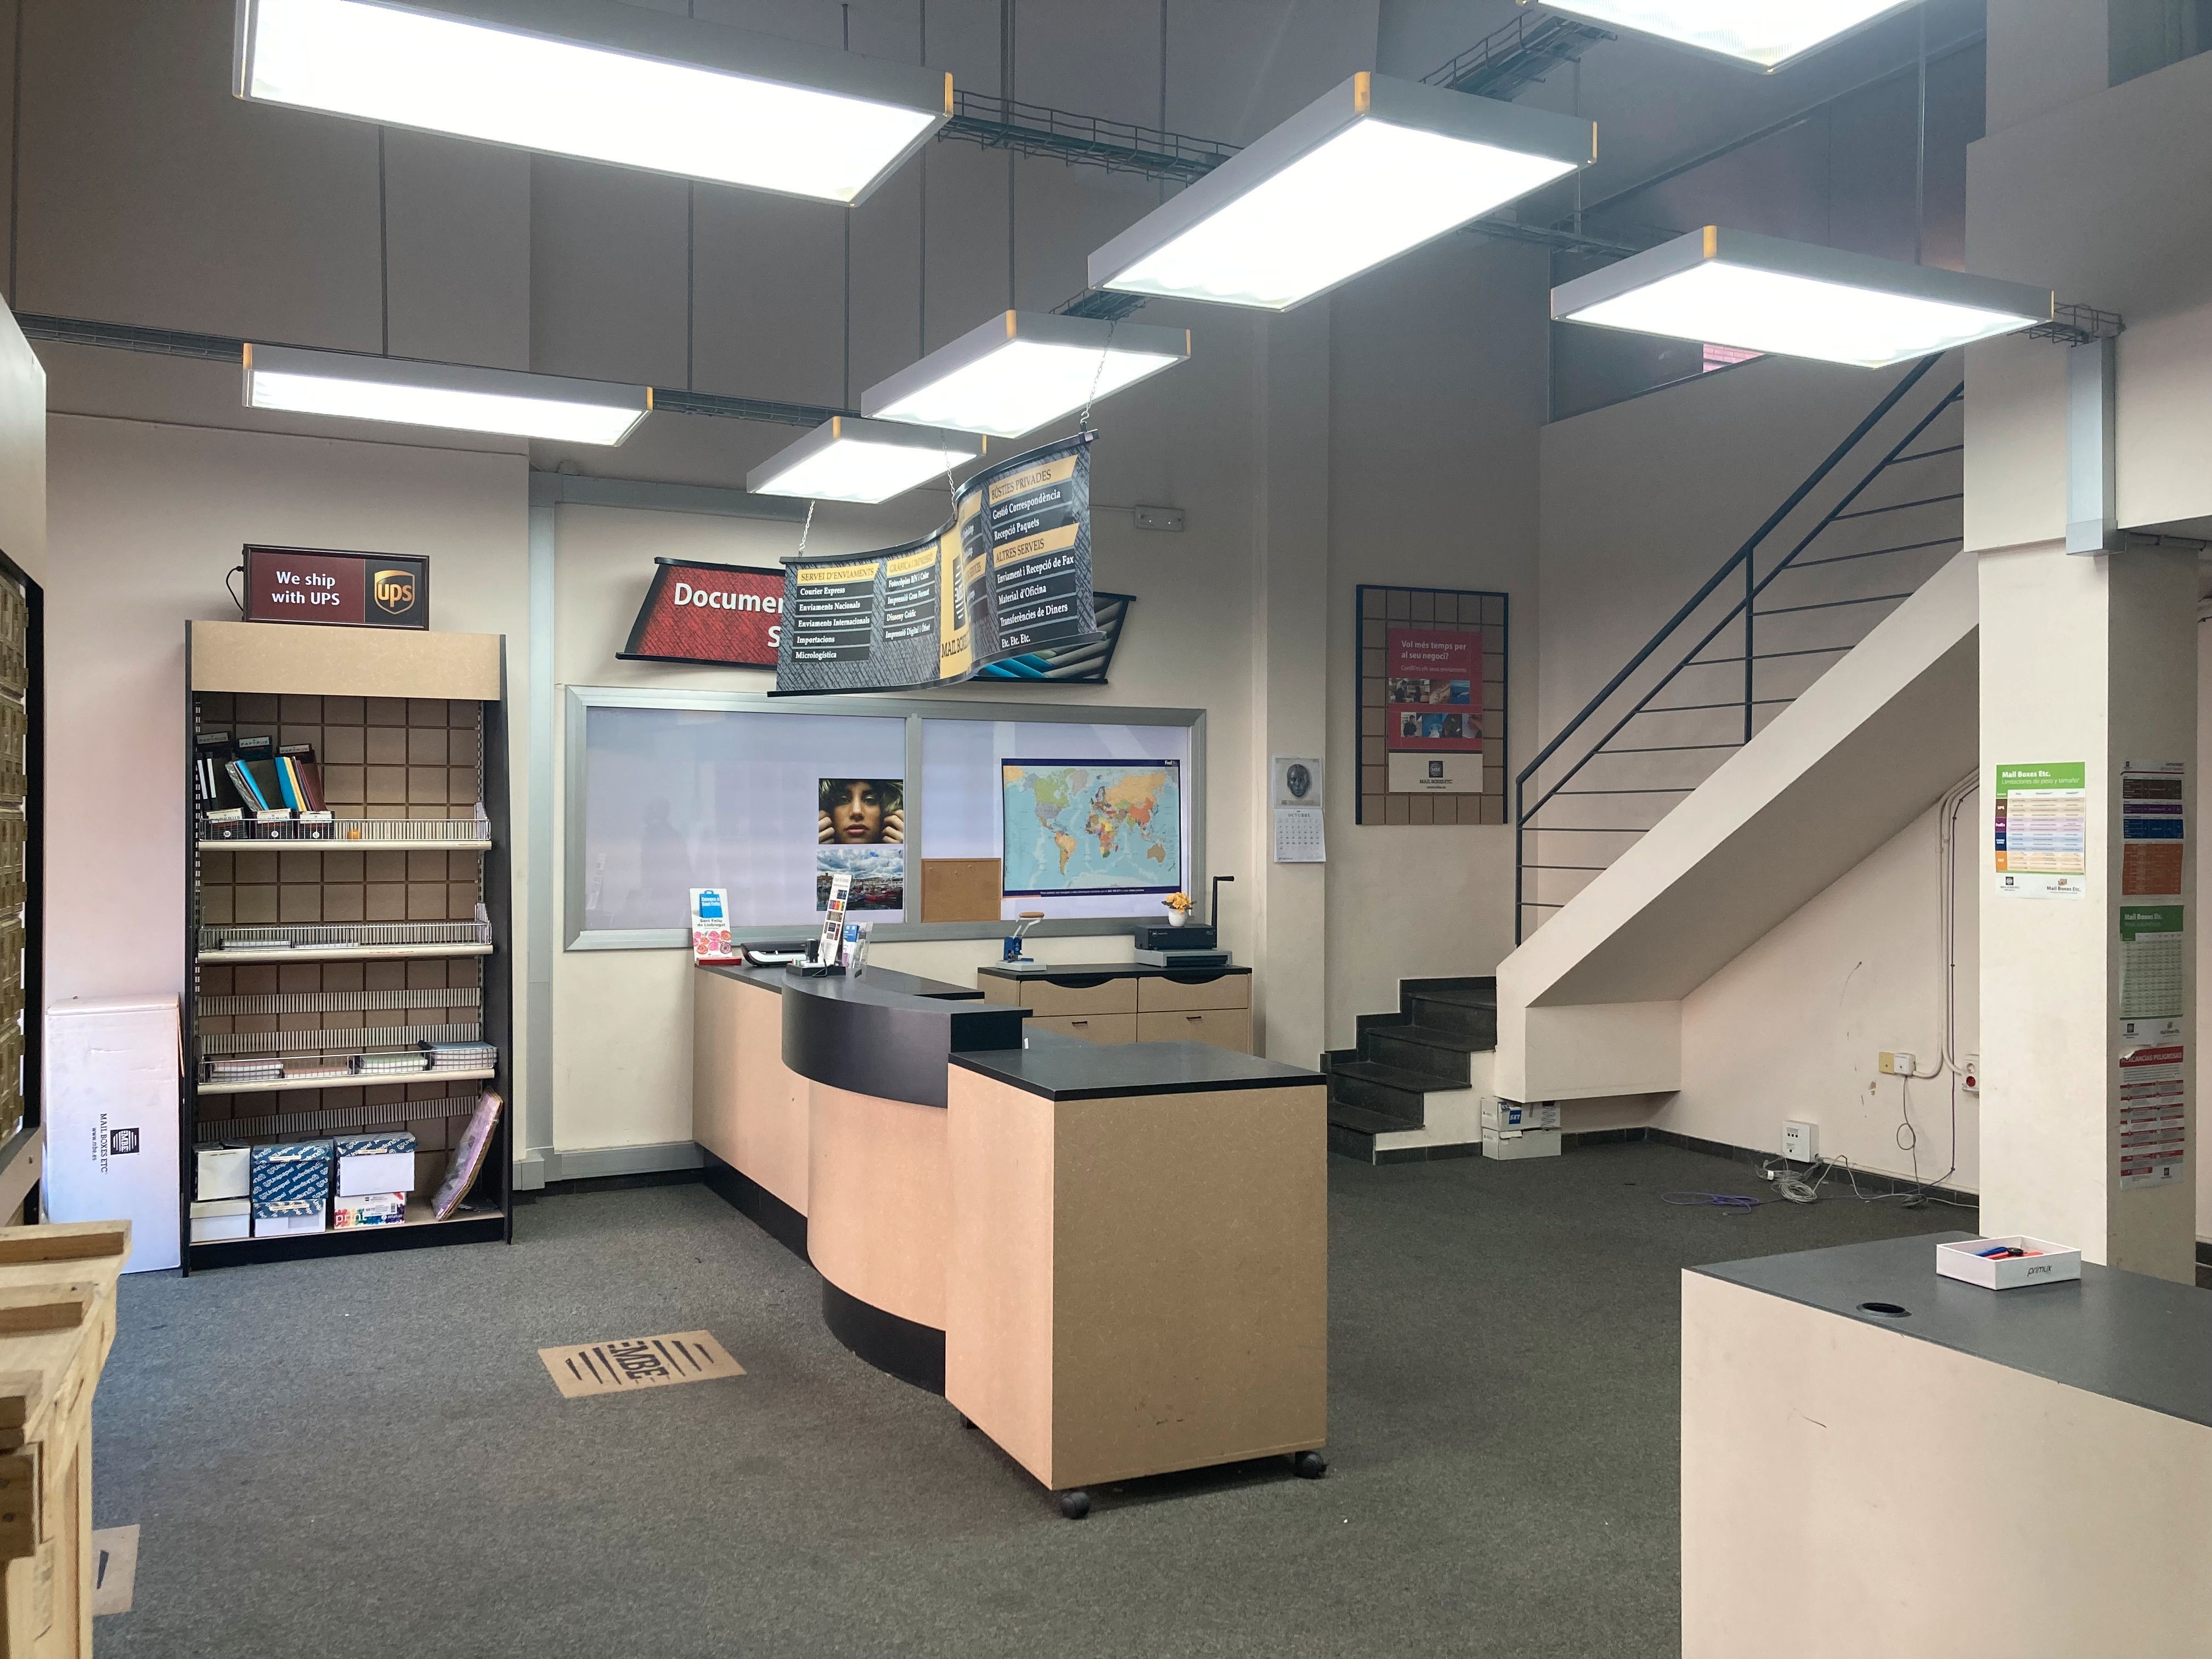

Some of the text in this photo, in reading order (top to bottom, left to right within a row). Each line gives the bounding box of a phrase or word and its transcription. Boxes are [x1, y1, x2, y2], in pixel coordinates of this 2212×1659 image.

[991, 469, 1051, 500] BÚSTIES PRIVADES
[992, 489, 1061, 520] Gestió Correspondència
[994, 518, 1040, 541] Recepció Paquets
[996, 538, 1045, 563] ALTRES SERVEIS
[889, 561, 911, 573] GRÀFICA
[997, 555, 1074, 584] Enviament i Recepció de Fax
[276, 571, 336, 590] We ship
[801, 573, 825, 581] SERVEI
[272, 590, 340, 606] with UPS
[377, 583, 413, 608] ups
[800, 586, 845, 596] Courier Express
[887, 588, 930, 606] Impressió Gran Format
[998, 590, 1019, 605] Material
[799, 600, 860, 612] Enviaments Nacionals
[798, 616, 870, 628] Enviaments Internacionals
[886, 612, 904, 622] Disseny
[1000, 604, 1068, 627] Transferències de Diners
[797, 636, 835, 645] Importacions
[885, 628, 906, 641] Impressió
[906, 625, 919, 637] Digital
[1001, 634, 1031, 648] Etc. Etc. Etc.
[941, 639, 956, 658] MAIL
[1431, 642, 1453, 651] temps
[795, 651, 837, 661] Micrologística
[1423, 652, 1449, 661] negoci?
[121, 1133, 129, 1153] MBE
[2027, 1265, 2052, 1277] primux
[612, 1344, 669, 1380] MBE
